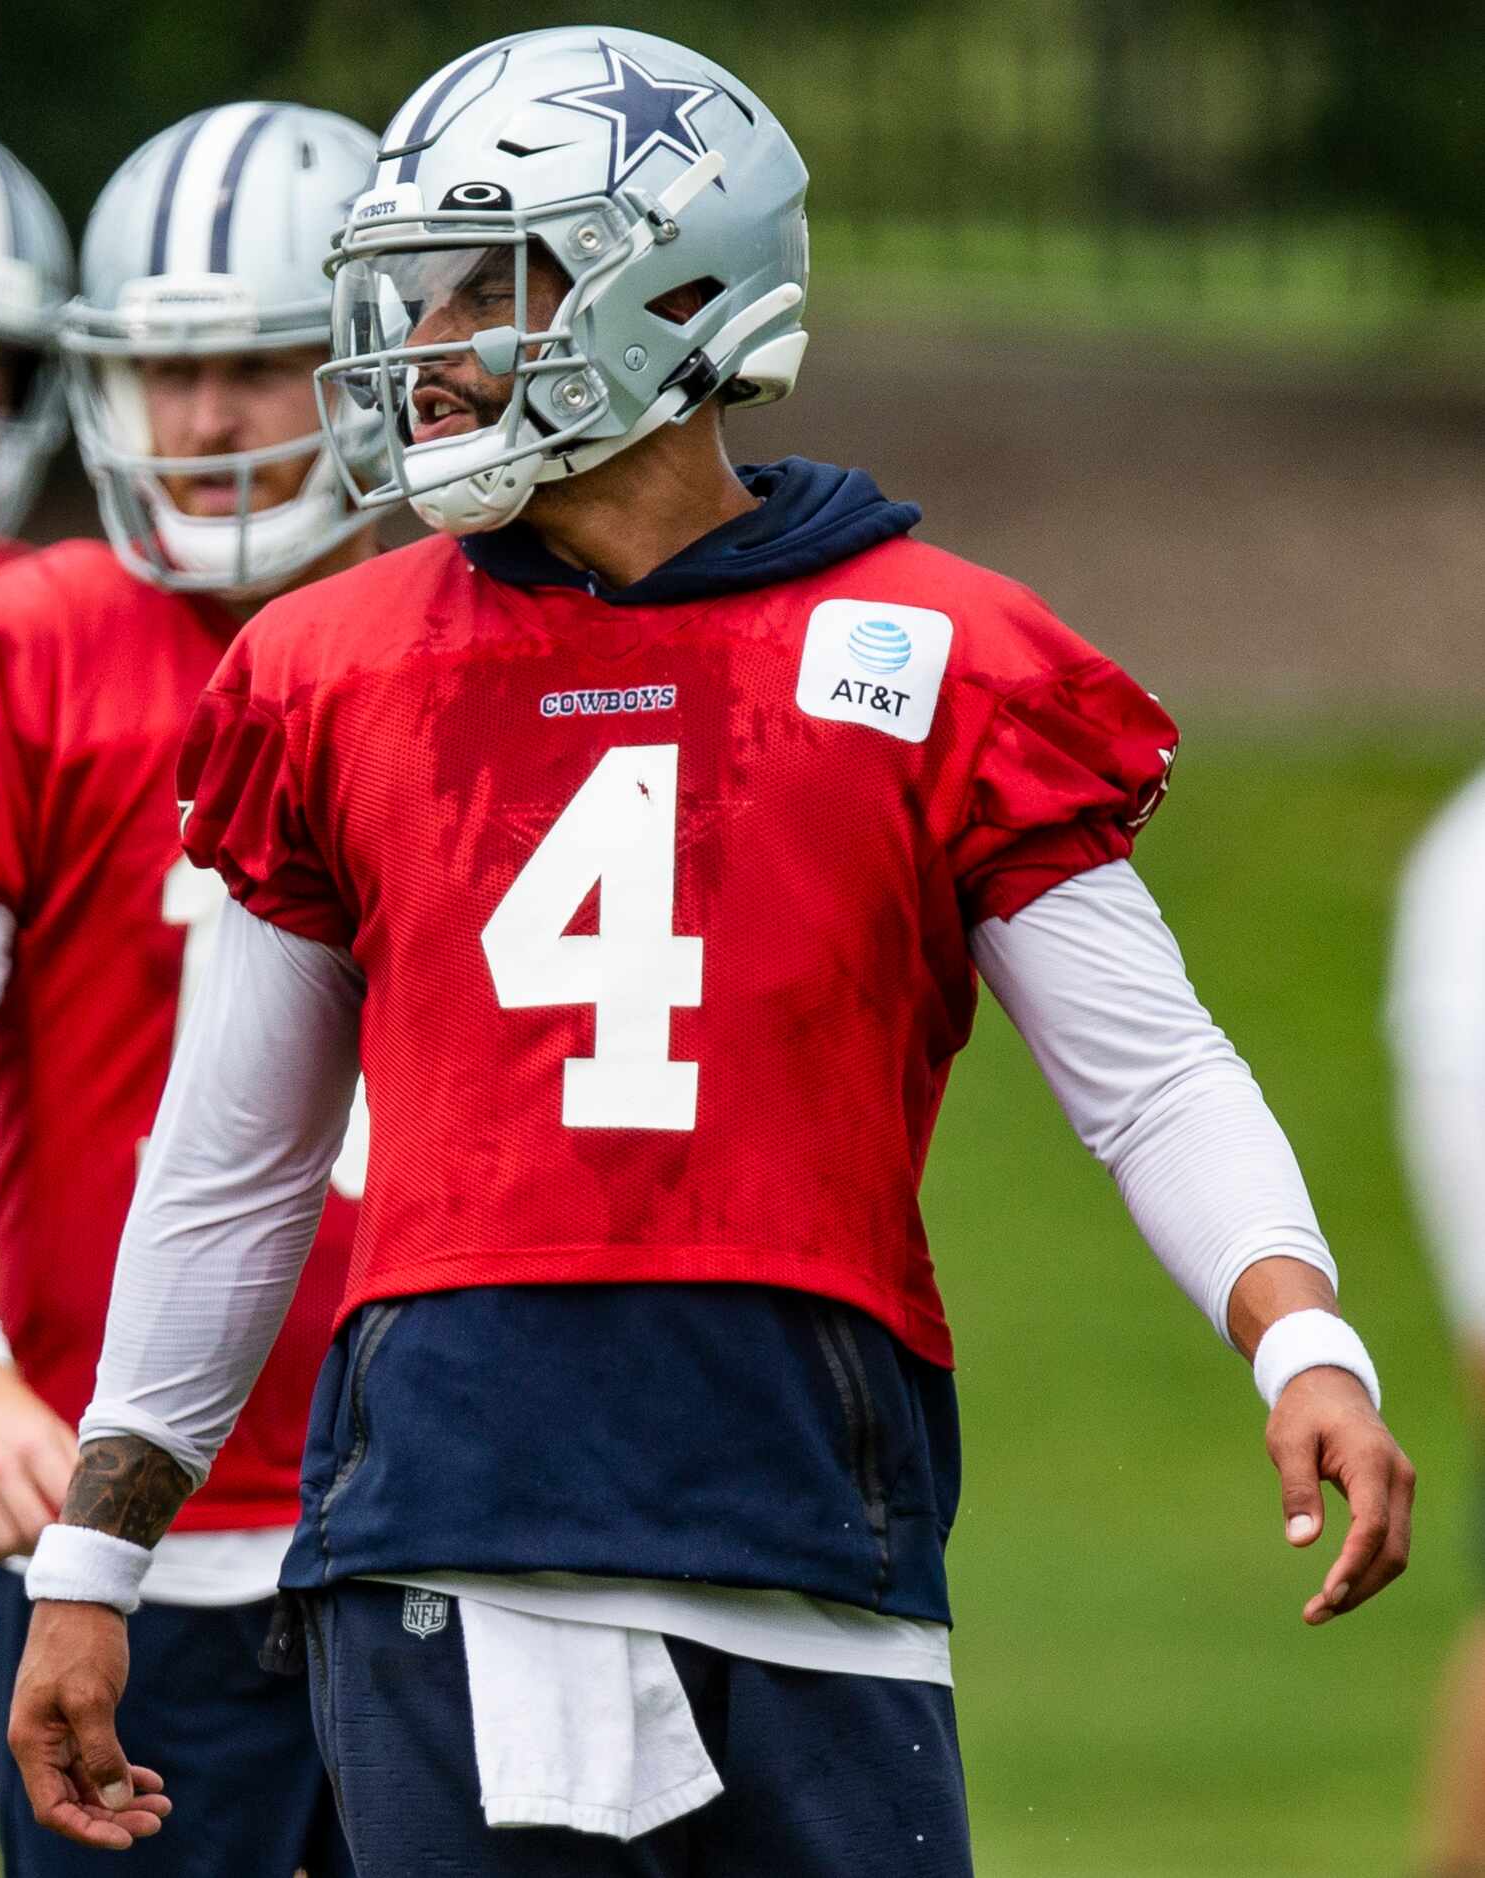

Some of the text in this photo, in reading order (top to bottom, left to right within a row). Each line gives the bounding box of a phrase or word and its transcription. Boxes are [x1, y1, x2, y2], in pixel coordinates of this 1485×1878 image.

[356, 200, 397, 219] WBOYS
[541, 684, 677, 717] COWBOYS
[830, 678, 911, 717] AT&T
[480, 743, 704, 1132] 4
[407, 1604, 442, 1628] NFL
